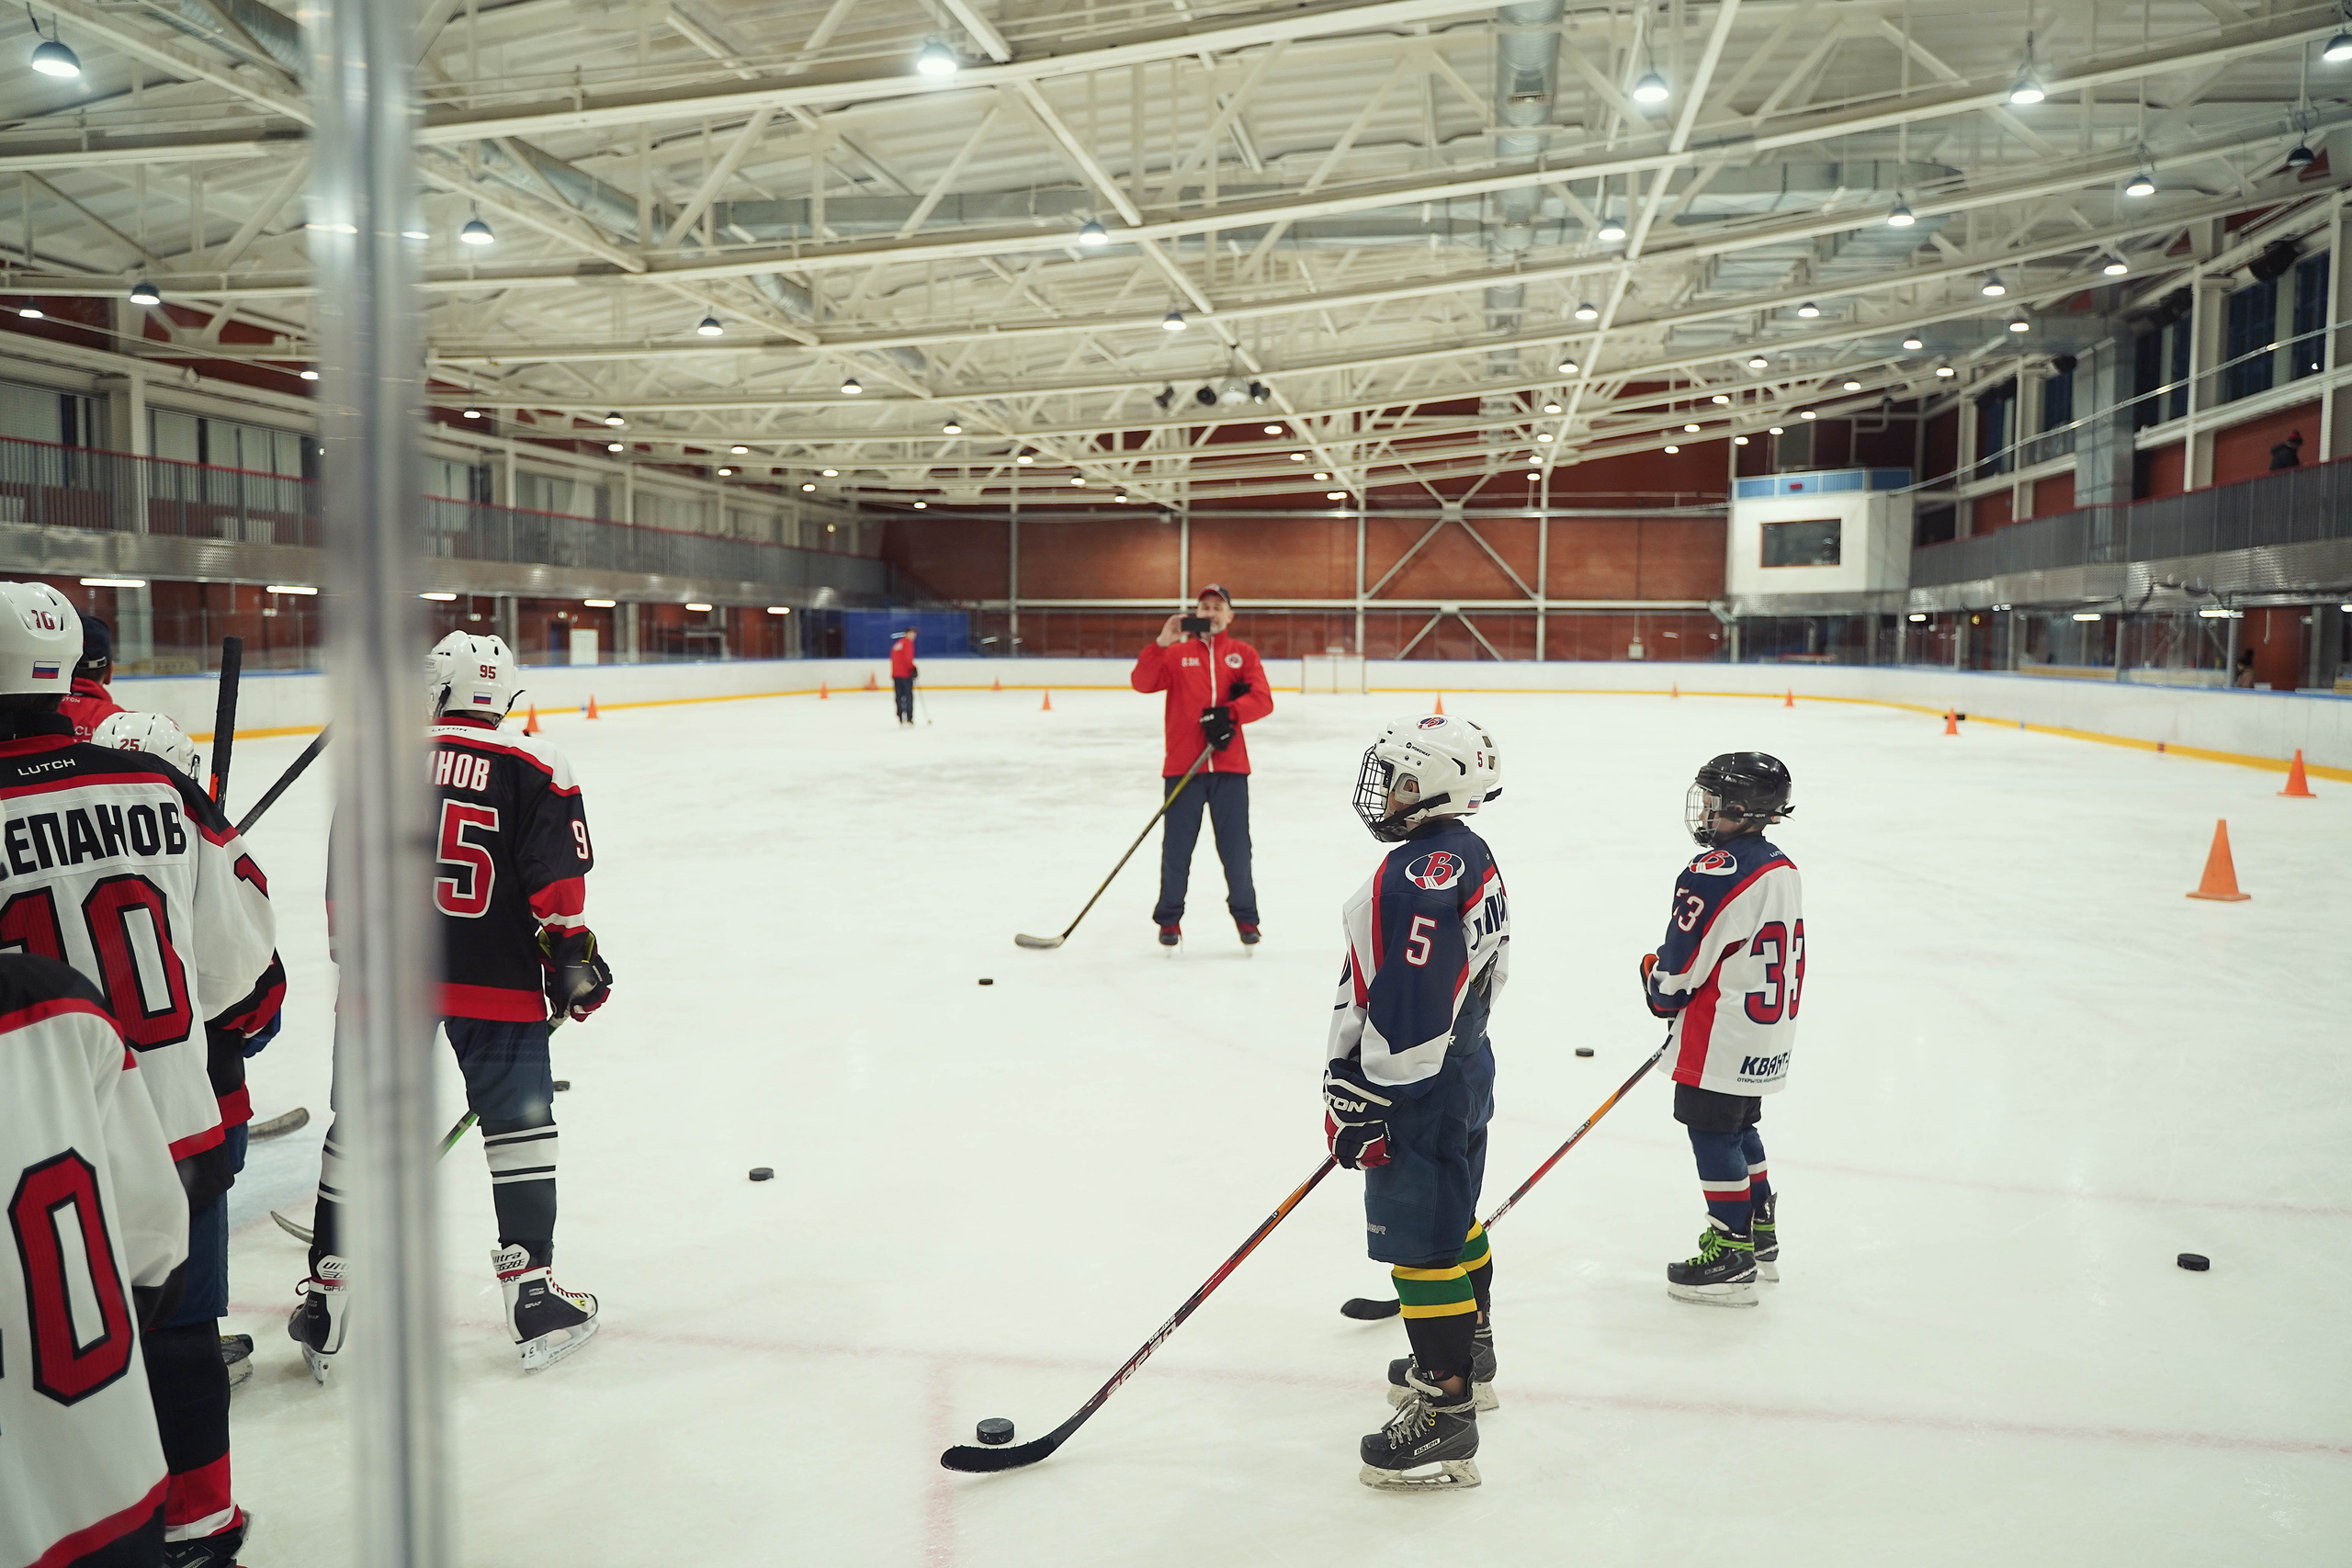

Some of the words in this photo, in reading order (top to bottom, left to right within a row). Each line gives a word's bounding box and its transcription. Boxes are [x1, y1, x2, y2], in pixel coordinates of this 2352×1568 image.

[480, 664, 497, 680] 95
[119, 738, 141, 751] 25
[1476, 750, 1484, 768] 5
[17, 758, 77, 777] LUTCH
[0, 801, 187, 881] ЕПАНОВ
[571, 818, 590, 861] 9
[1404, 913, 1438, 968] 5
[1744, 918, 1806, 1026] 33
[1739, 1048, 1792, 1077] КВАНТ-
